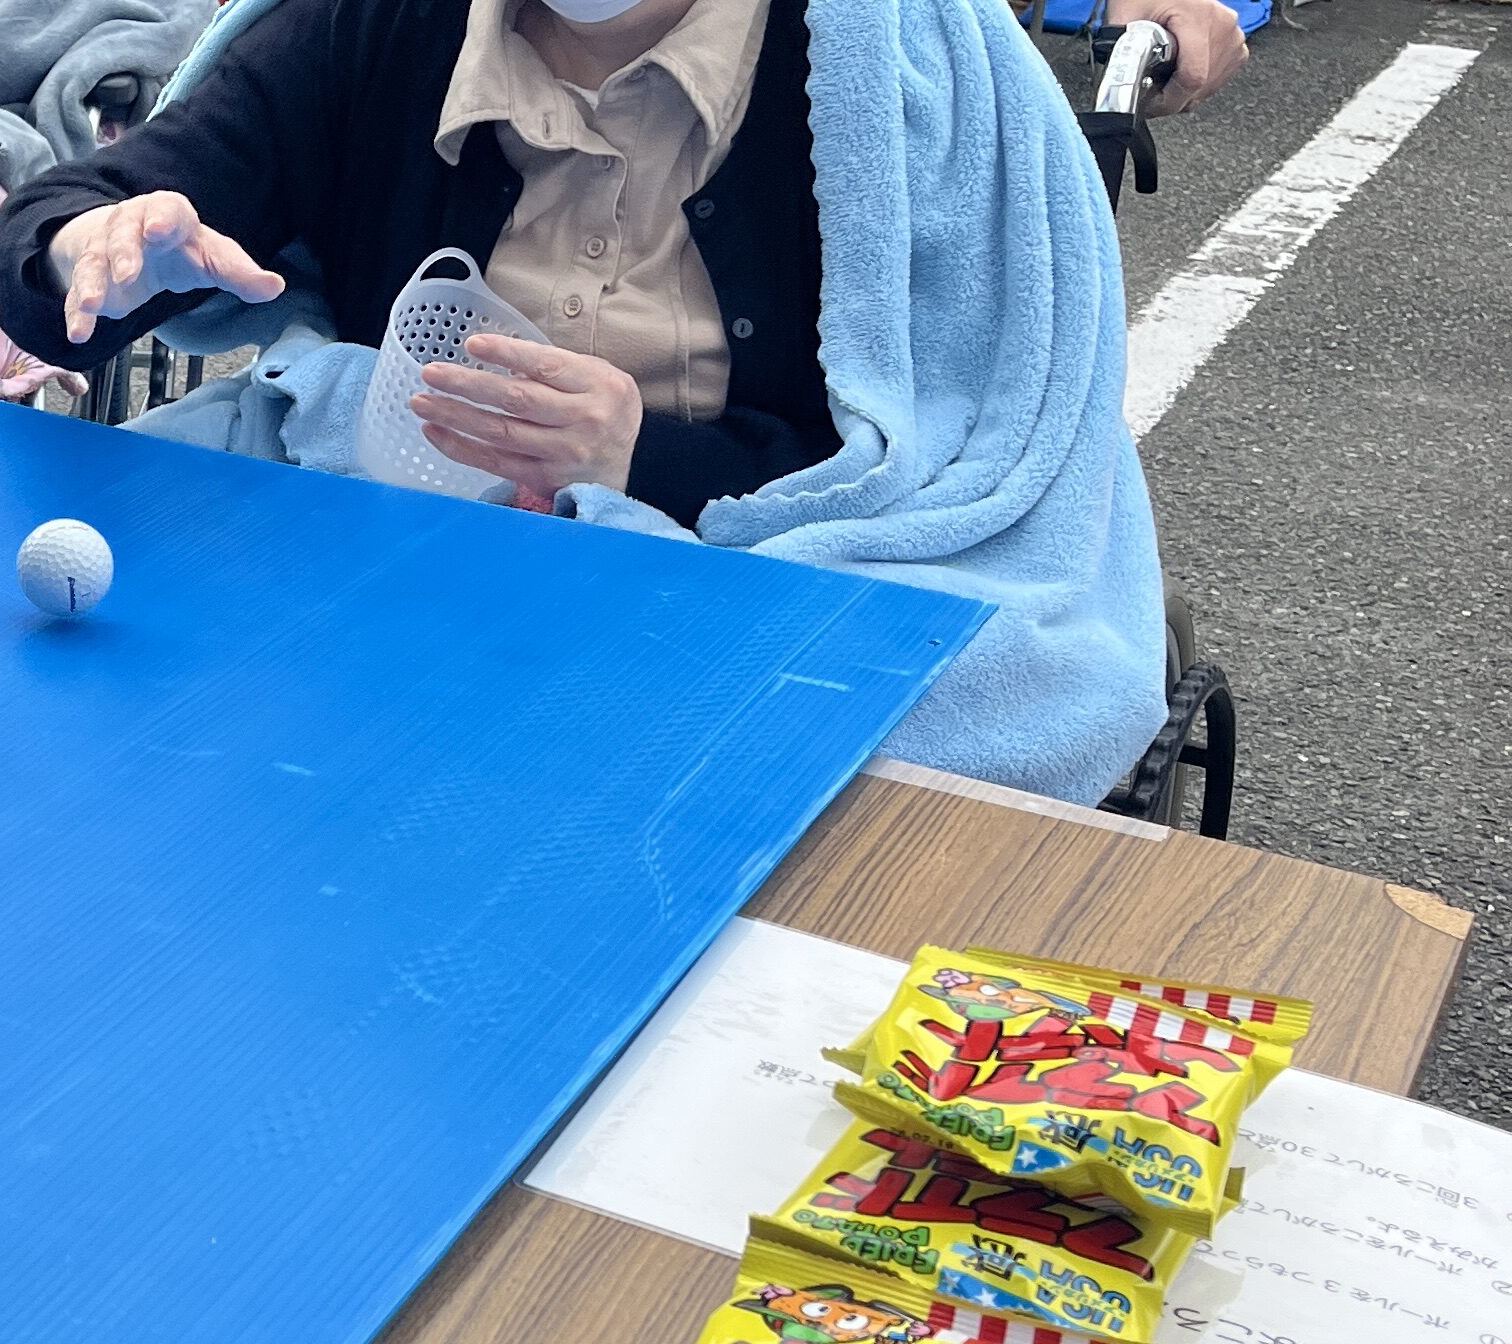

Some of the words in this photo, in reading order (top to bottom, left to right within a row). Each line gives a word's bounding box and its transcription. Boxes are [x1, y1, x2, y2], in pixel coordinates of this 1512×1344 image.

[892, 1049, 1221, 1147] フライド
[792, 1209, 931, 1247] POTATO
[809, 1166, 1156, 1282] フライド
[840, 1234, 941, 1275] FRIED
[960, 1234, 1027, 1281] 感
[1037, 1258, 1133, 1334] USA
